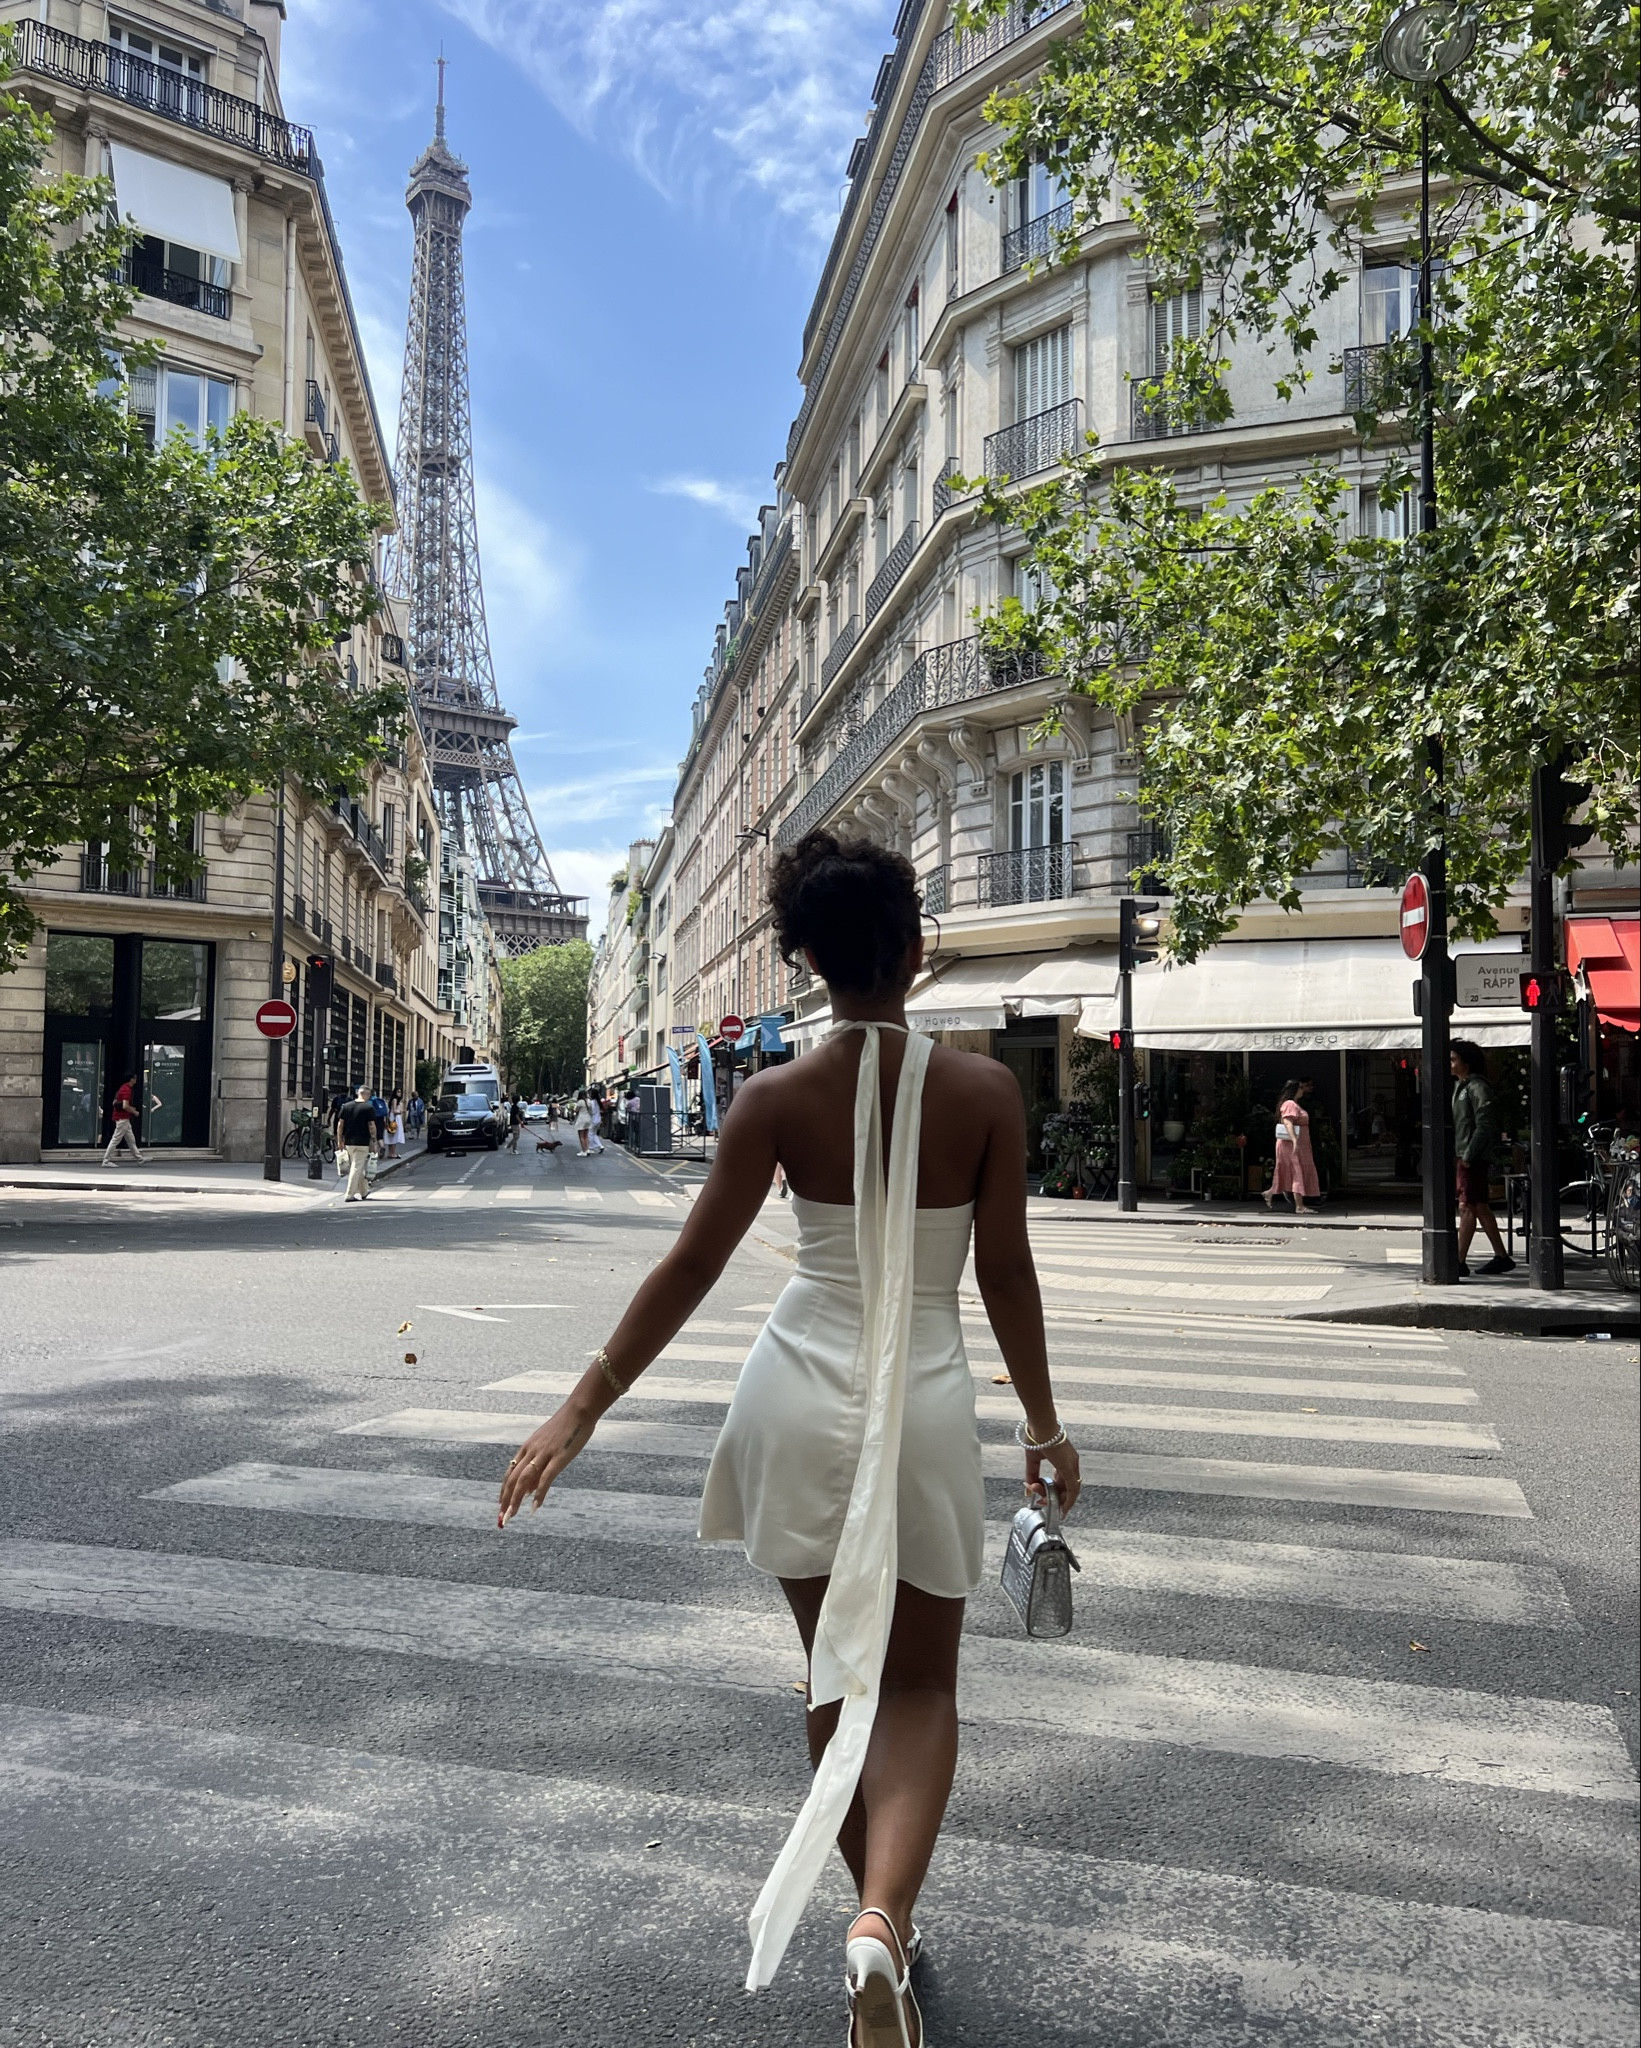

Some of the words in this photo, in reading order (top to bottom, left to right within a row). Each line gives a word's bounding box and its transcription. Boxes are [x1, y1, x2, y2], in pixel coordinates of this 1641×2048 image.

[1478, 966, 1520, 975] Avenue
[1483, 977, 1515, 989] RAPP
[1470, 994, 1479, 1002] 20
